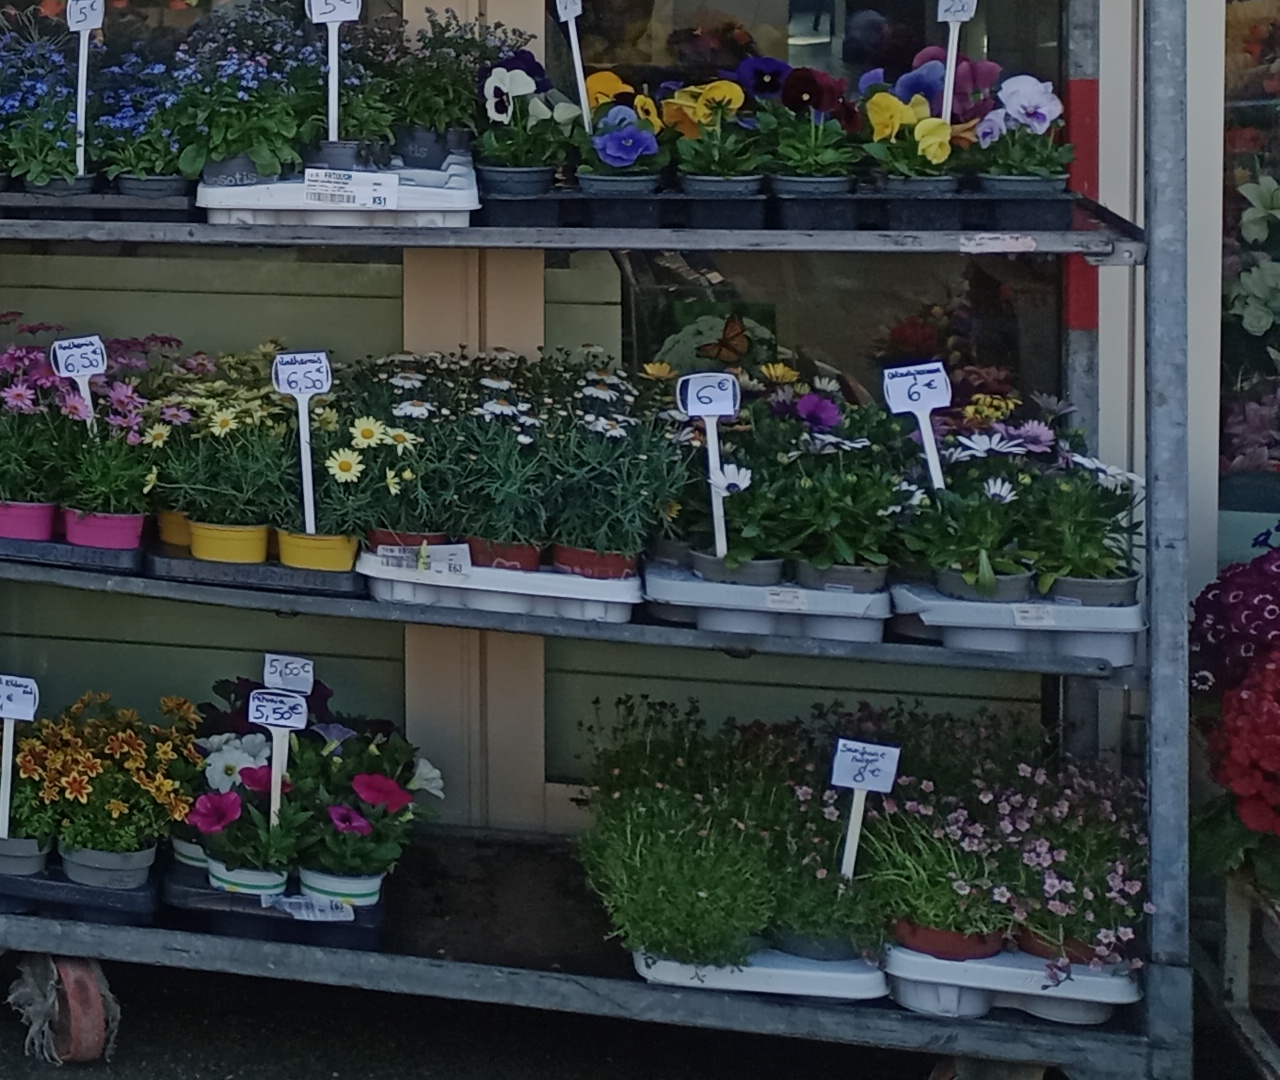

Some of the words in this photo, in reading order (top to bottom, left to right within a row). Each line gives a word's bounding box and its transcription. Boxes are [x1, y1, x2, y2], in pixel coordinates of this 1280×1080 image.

[64, 349, 101, 373] 6,50€
[287, 366, 324, 392] 6,50€
[696, 379, 729, 404] 6€
[908, 381, 937, 401] 6€
[269, 659, 312, 678] 5,50€
[253, 705, 304, 723] 5,50€
